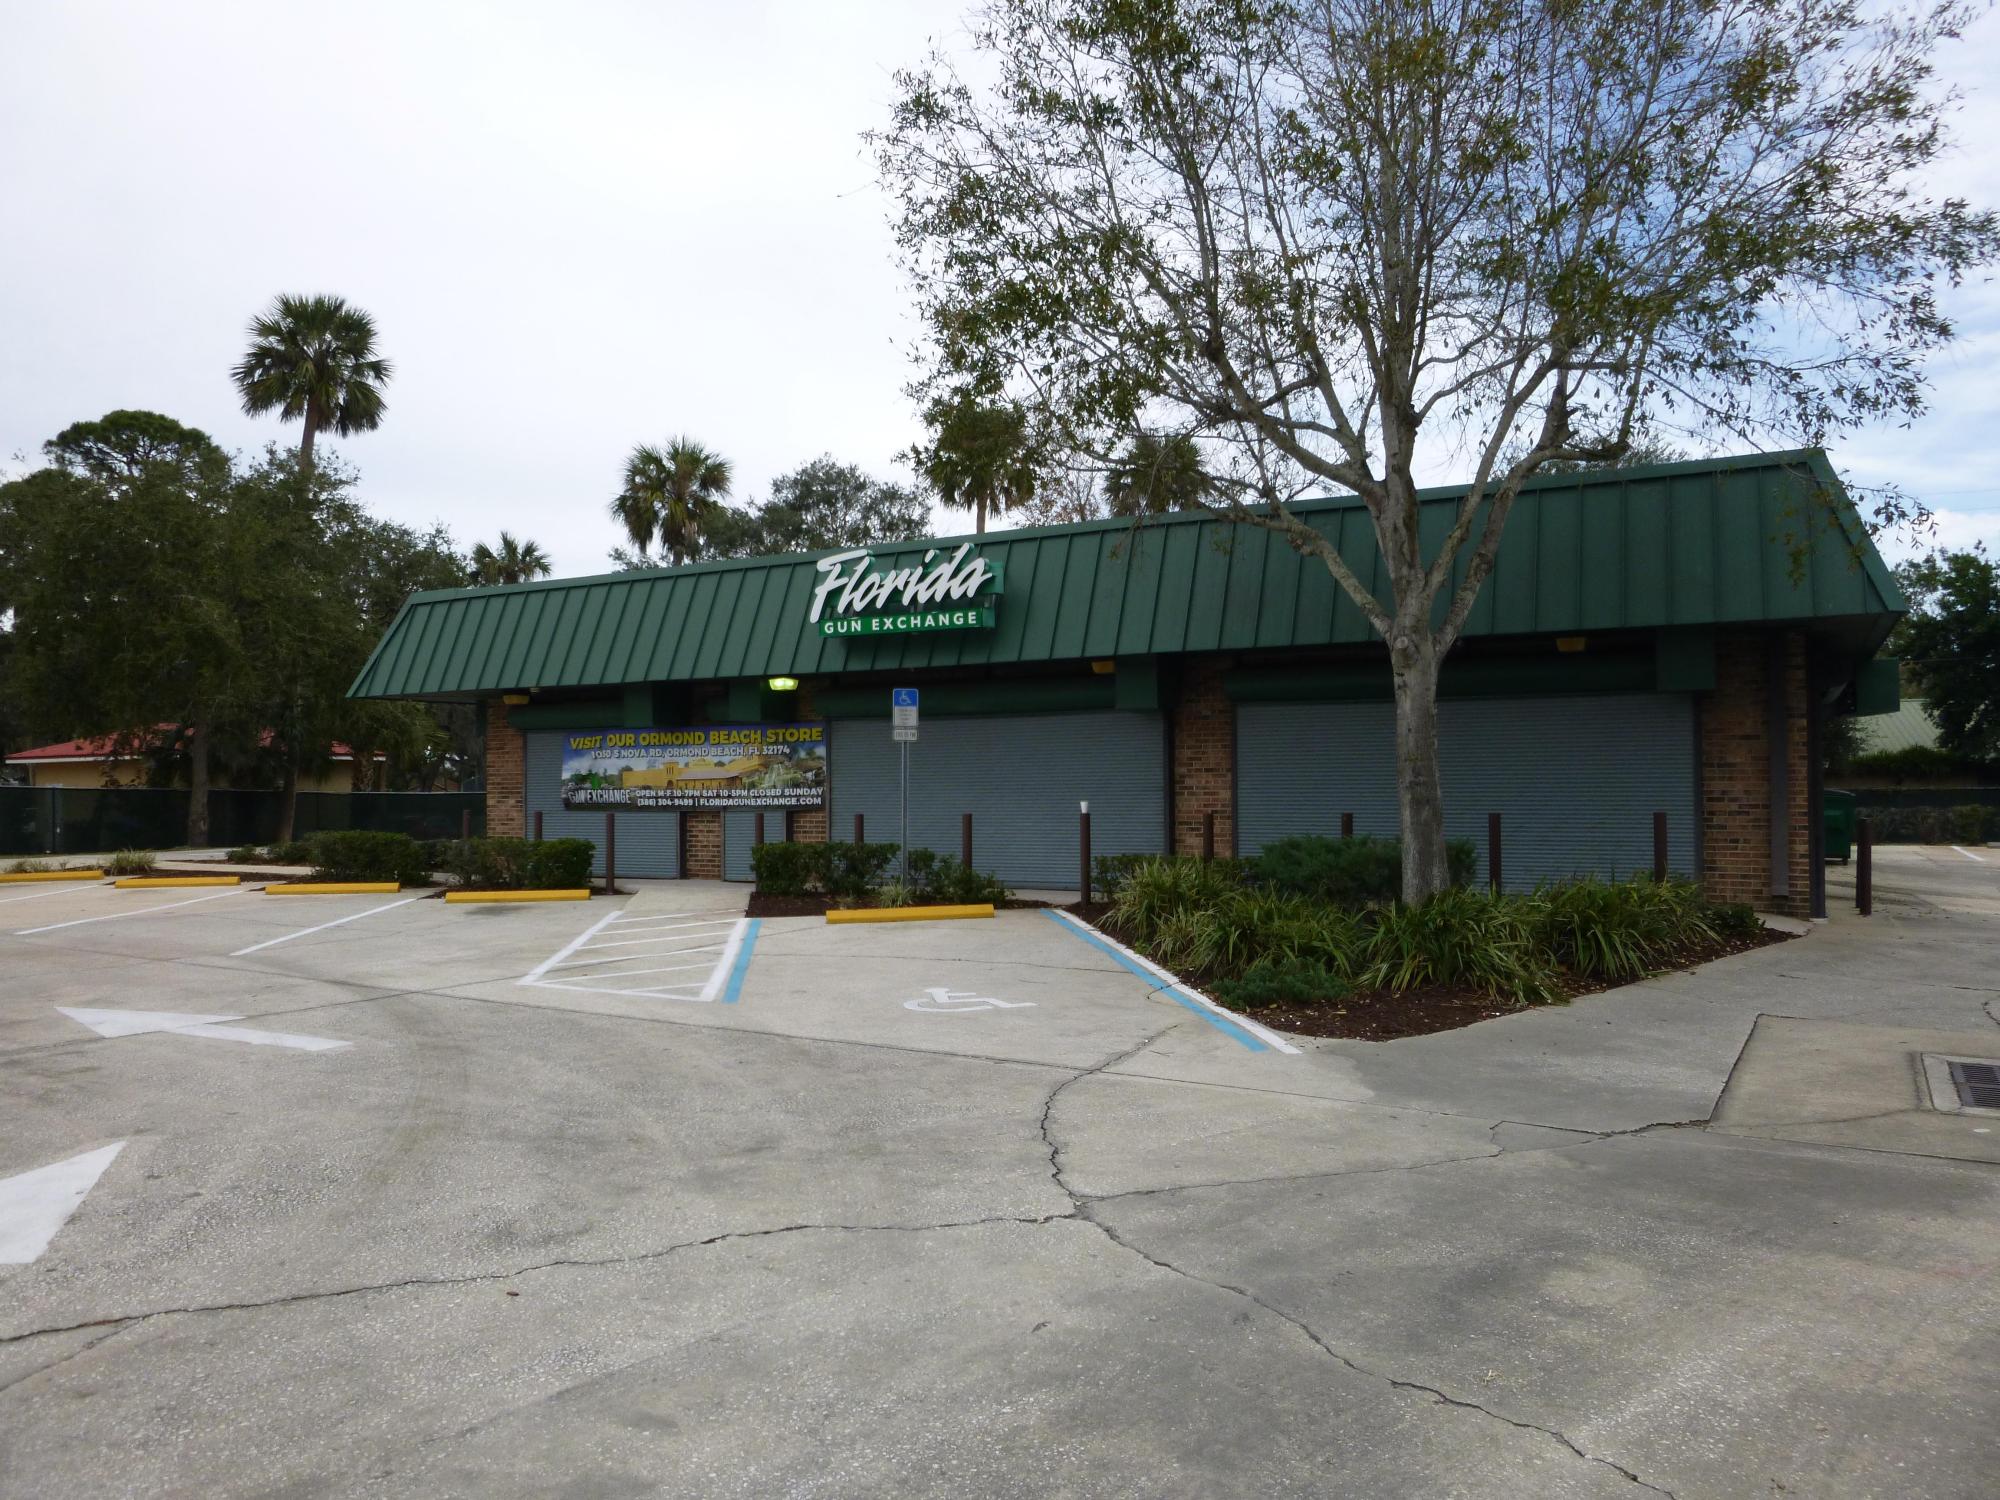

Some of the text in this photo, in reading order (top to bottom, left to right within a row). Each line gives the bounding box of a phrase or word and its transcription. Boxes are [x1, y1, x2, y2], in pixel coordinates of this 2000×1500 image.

[809, 542, 992, 624] Florida
[824, 611, 977, 634] GUN EXCHANGE
[570, 727, 824, 750] VISIT OUR ORMOND BEACH STORE
[621, 749, 647, 758] NOVA
[666, 748, 708, 757] ORMOND
[748, 747, 760, 755] FL
[762, 745, 790, 755] 32174
[587, 789, 631, 804] EXCHANGE
[702, 789, 717, 797] SAT
[720, 789, 748, 797] 10-5PM
[750, 788, 782, 797] CLOSED
[784, 787, 824, 796] SUNDAY
[700, 797, 822, 806] FLORIDAGUNEXCHANGE.COM
